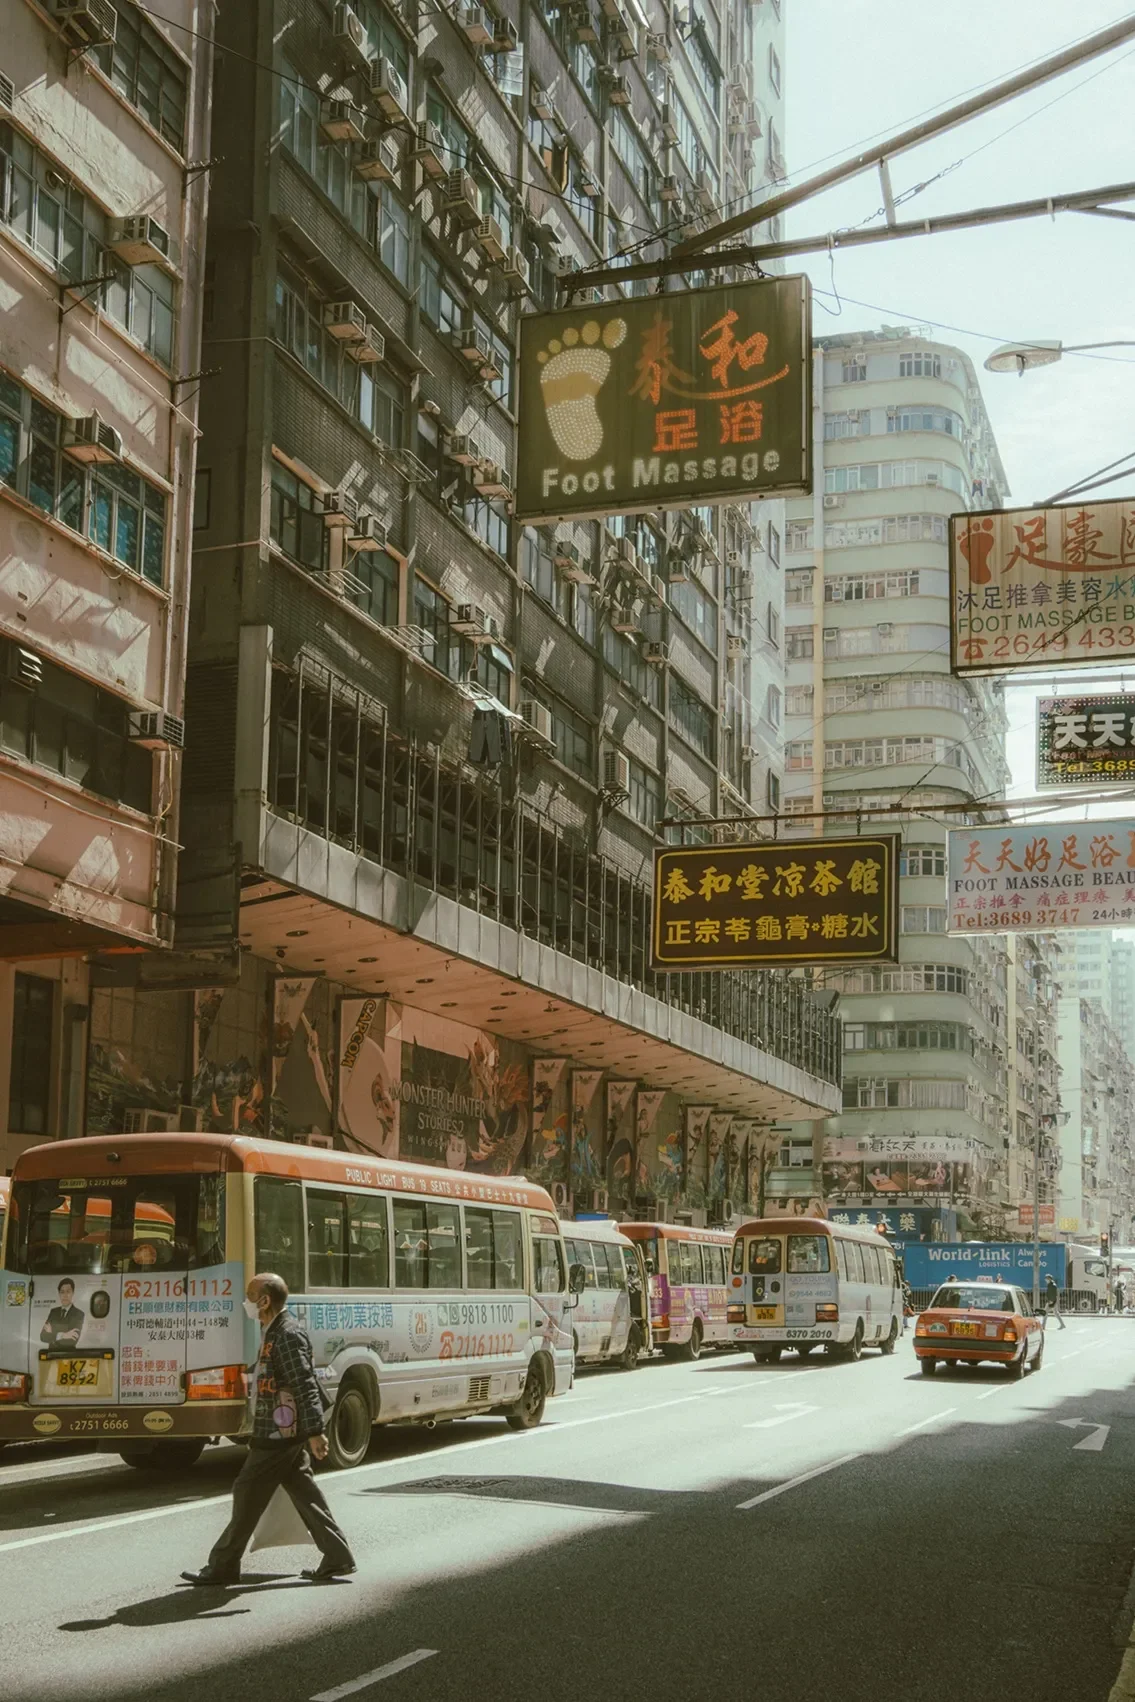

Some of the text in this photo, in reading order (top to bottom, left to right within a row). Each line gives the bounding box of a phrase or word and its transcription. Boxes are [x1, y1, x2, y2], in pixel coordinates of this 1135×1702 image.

[652, 400, 764, 452] 足浴
[542, 450, 780, 497] Foot Massage
[957, 575, 1135, 612] 沐足推拿美容水
[959, 615, 1012, 634] FOOT
[1018, 606, 1117, 629] MASSAGE
[994, 631, 1068, 657] 2649
[1054, 713, 1135, 749] 天天
[954, 878, 997, 893] FOOT
[1005, 873, 1084, 890] MASSAGE
[953, 893, 1027, 910] 正宗推拿
[1036, 909, 1081, 926] 3747
[340, 999, 376, 1069] CAPCOM
[448, 1092, 487, 1120] HUNTER
[345, 1168, 372, 1184] PUBLIC
[376, 1173, 397, 1188] LIGHT
[401, 1176, 416, 1190] BUS
[431, 1180, 452, 1194] SEATS
[1018, 1248, 1047, 1258] Alwys
[143, 1278, 232, 1297] 2116 1112
[462, 1304, 514, 1325] 9818 1100
[810, 1330, 833, 1339] 2010
[103, 1419, 129, 1430] 6666
